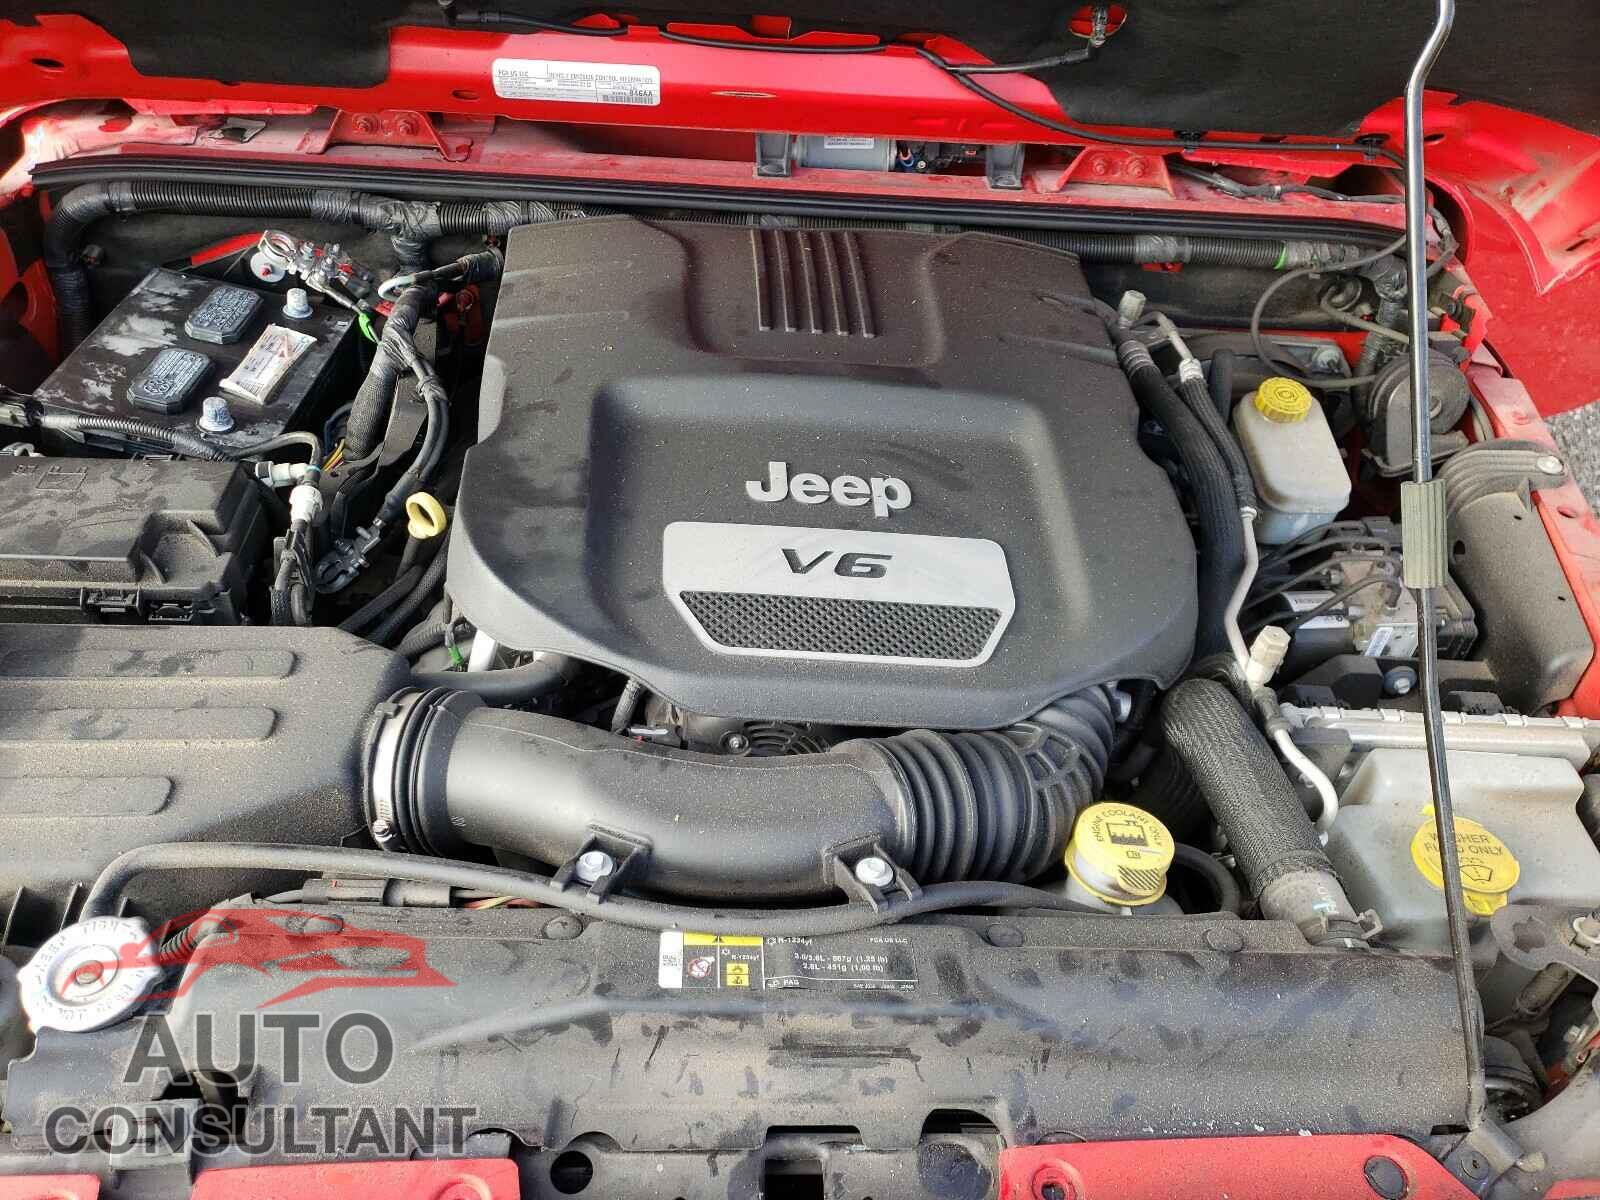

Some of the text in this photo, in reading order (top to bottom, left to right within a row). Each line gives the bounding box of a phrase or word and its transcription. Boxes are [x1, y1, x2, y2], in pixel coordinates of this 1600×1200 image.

[745, 461, 912, 518] Jeep
[781, 548, 893, 579] V6
[1469, 845, 1504, 857] ONLY
